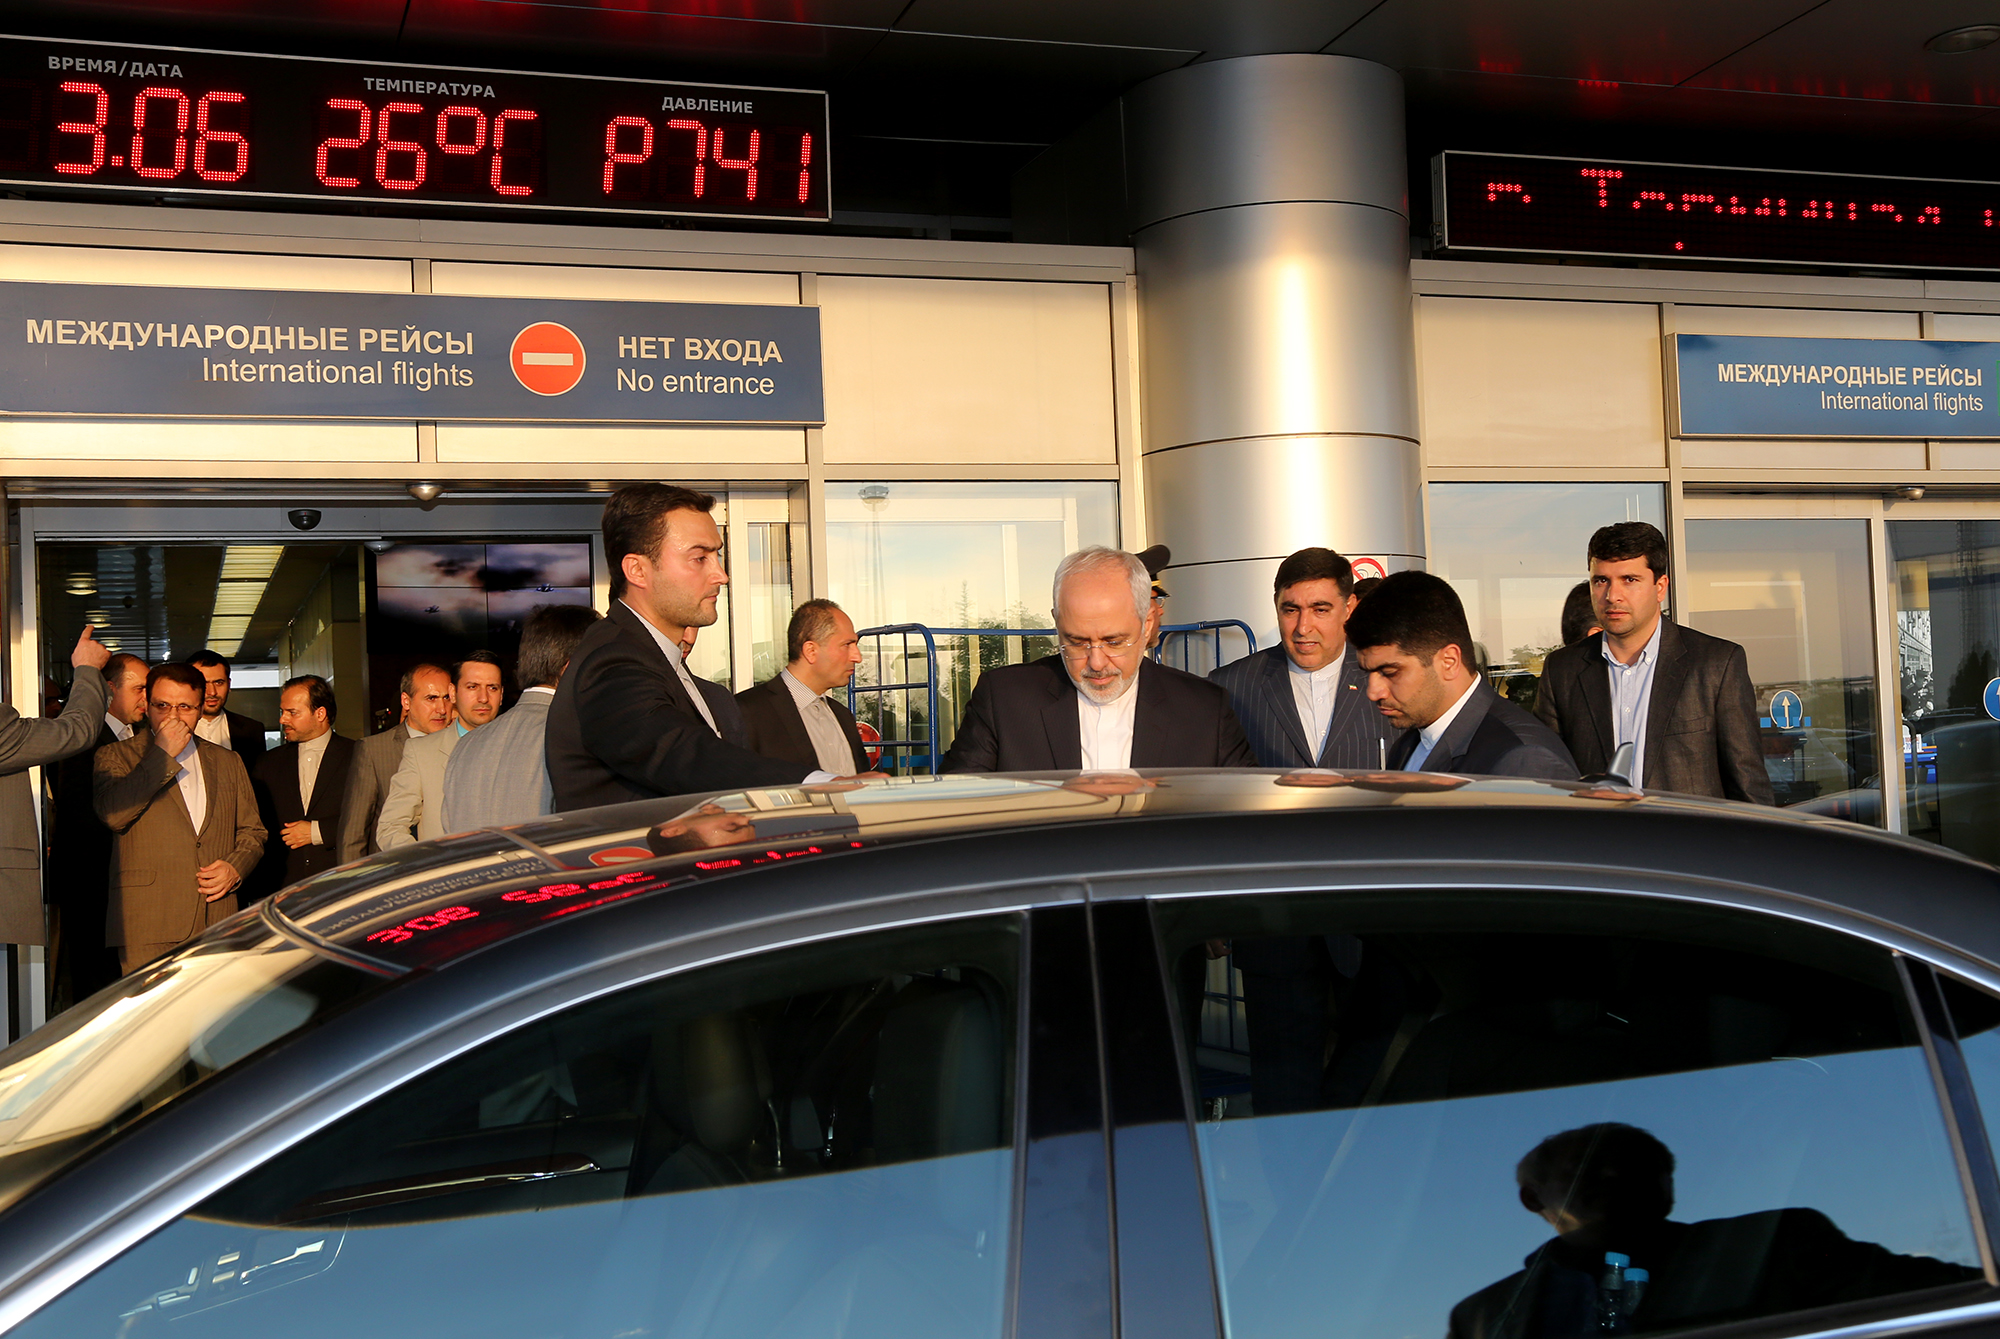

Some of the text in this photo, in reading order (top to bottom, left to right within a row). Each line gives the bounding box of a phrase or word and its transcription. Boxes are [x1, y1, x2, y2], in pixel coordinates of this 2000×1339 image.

[48, 56, 183, 78] ВРЕМЯ/ДАТА
[363, 77, 496, 98] ТЕМПЕРАТУРА
[661, 96, 753, 114] ДАВЛЕНИЕ
[54, 82, 249, 182] 3.06
[26, 320, 474, 355] МЕЖДУНАРОДНЫЕ РЕЙСЫ
[618, 337, 783, 366] НЕТ ВХОДА
[203, 358, 474, 391] International flights
[618, 368, 775, 395] No entrance
[1718, 363, 1982, 388] МЕЖДУНАРОДНЫЕ РЕЙСЫ
[1821, 390, 1984, 416] International flights
